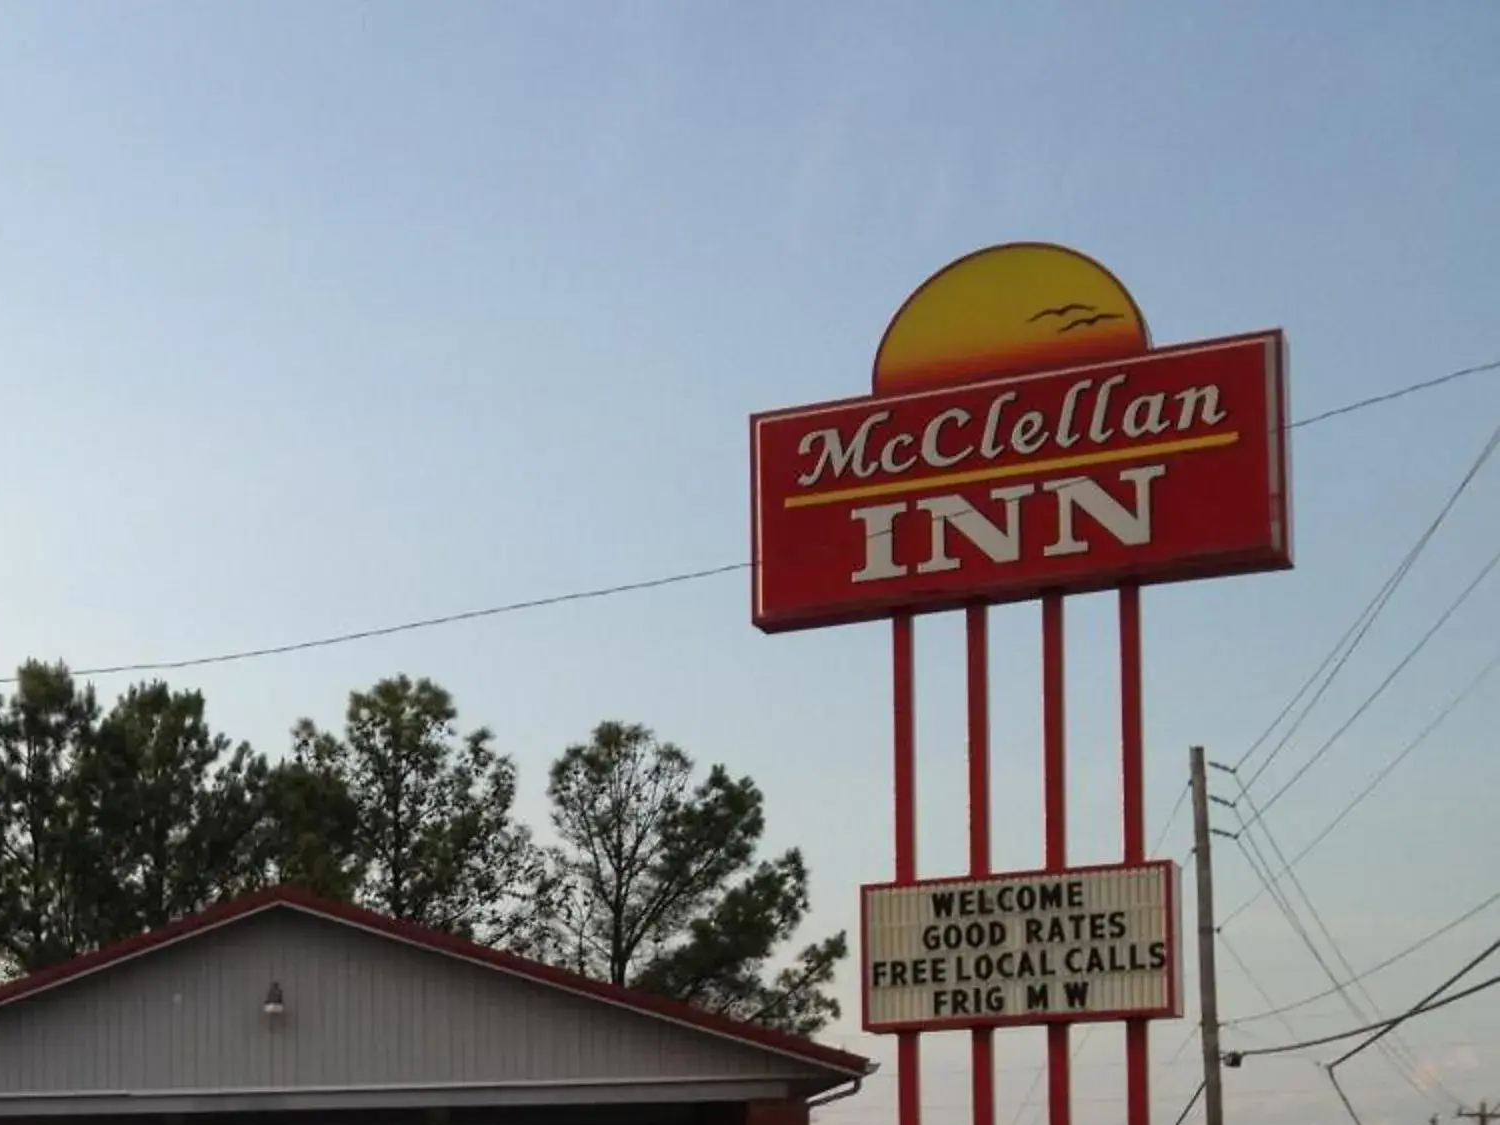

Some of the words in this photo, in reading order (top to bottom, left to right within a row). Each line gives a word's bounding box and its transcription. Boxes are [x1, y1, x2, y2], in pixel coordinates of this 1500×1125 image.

[797, 374, 1227, 486] McClellan
[851, 464, 1166, 583] INN
[932, 881, 1083, 918] WELCOME
[922, 920, 1007, 951] GOOD
[1025, 912, 1127, 945] RATES
[872, 957, 947, 988] FREE
[956, 951, 1056, 983] LOCAL
[1065, 942, 1167, 974] CALLS
[933, 986, 1004, 1016] FRIG
[1027, 984, 1049, 1012] M
[1064, 981, 1090, 1009] W
